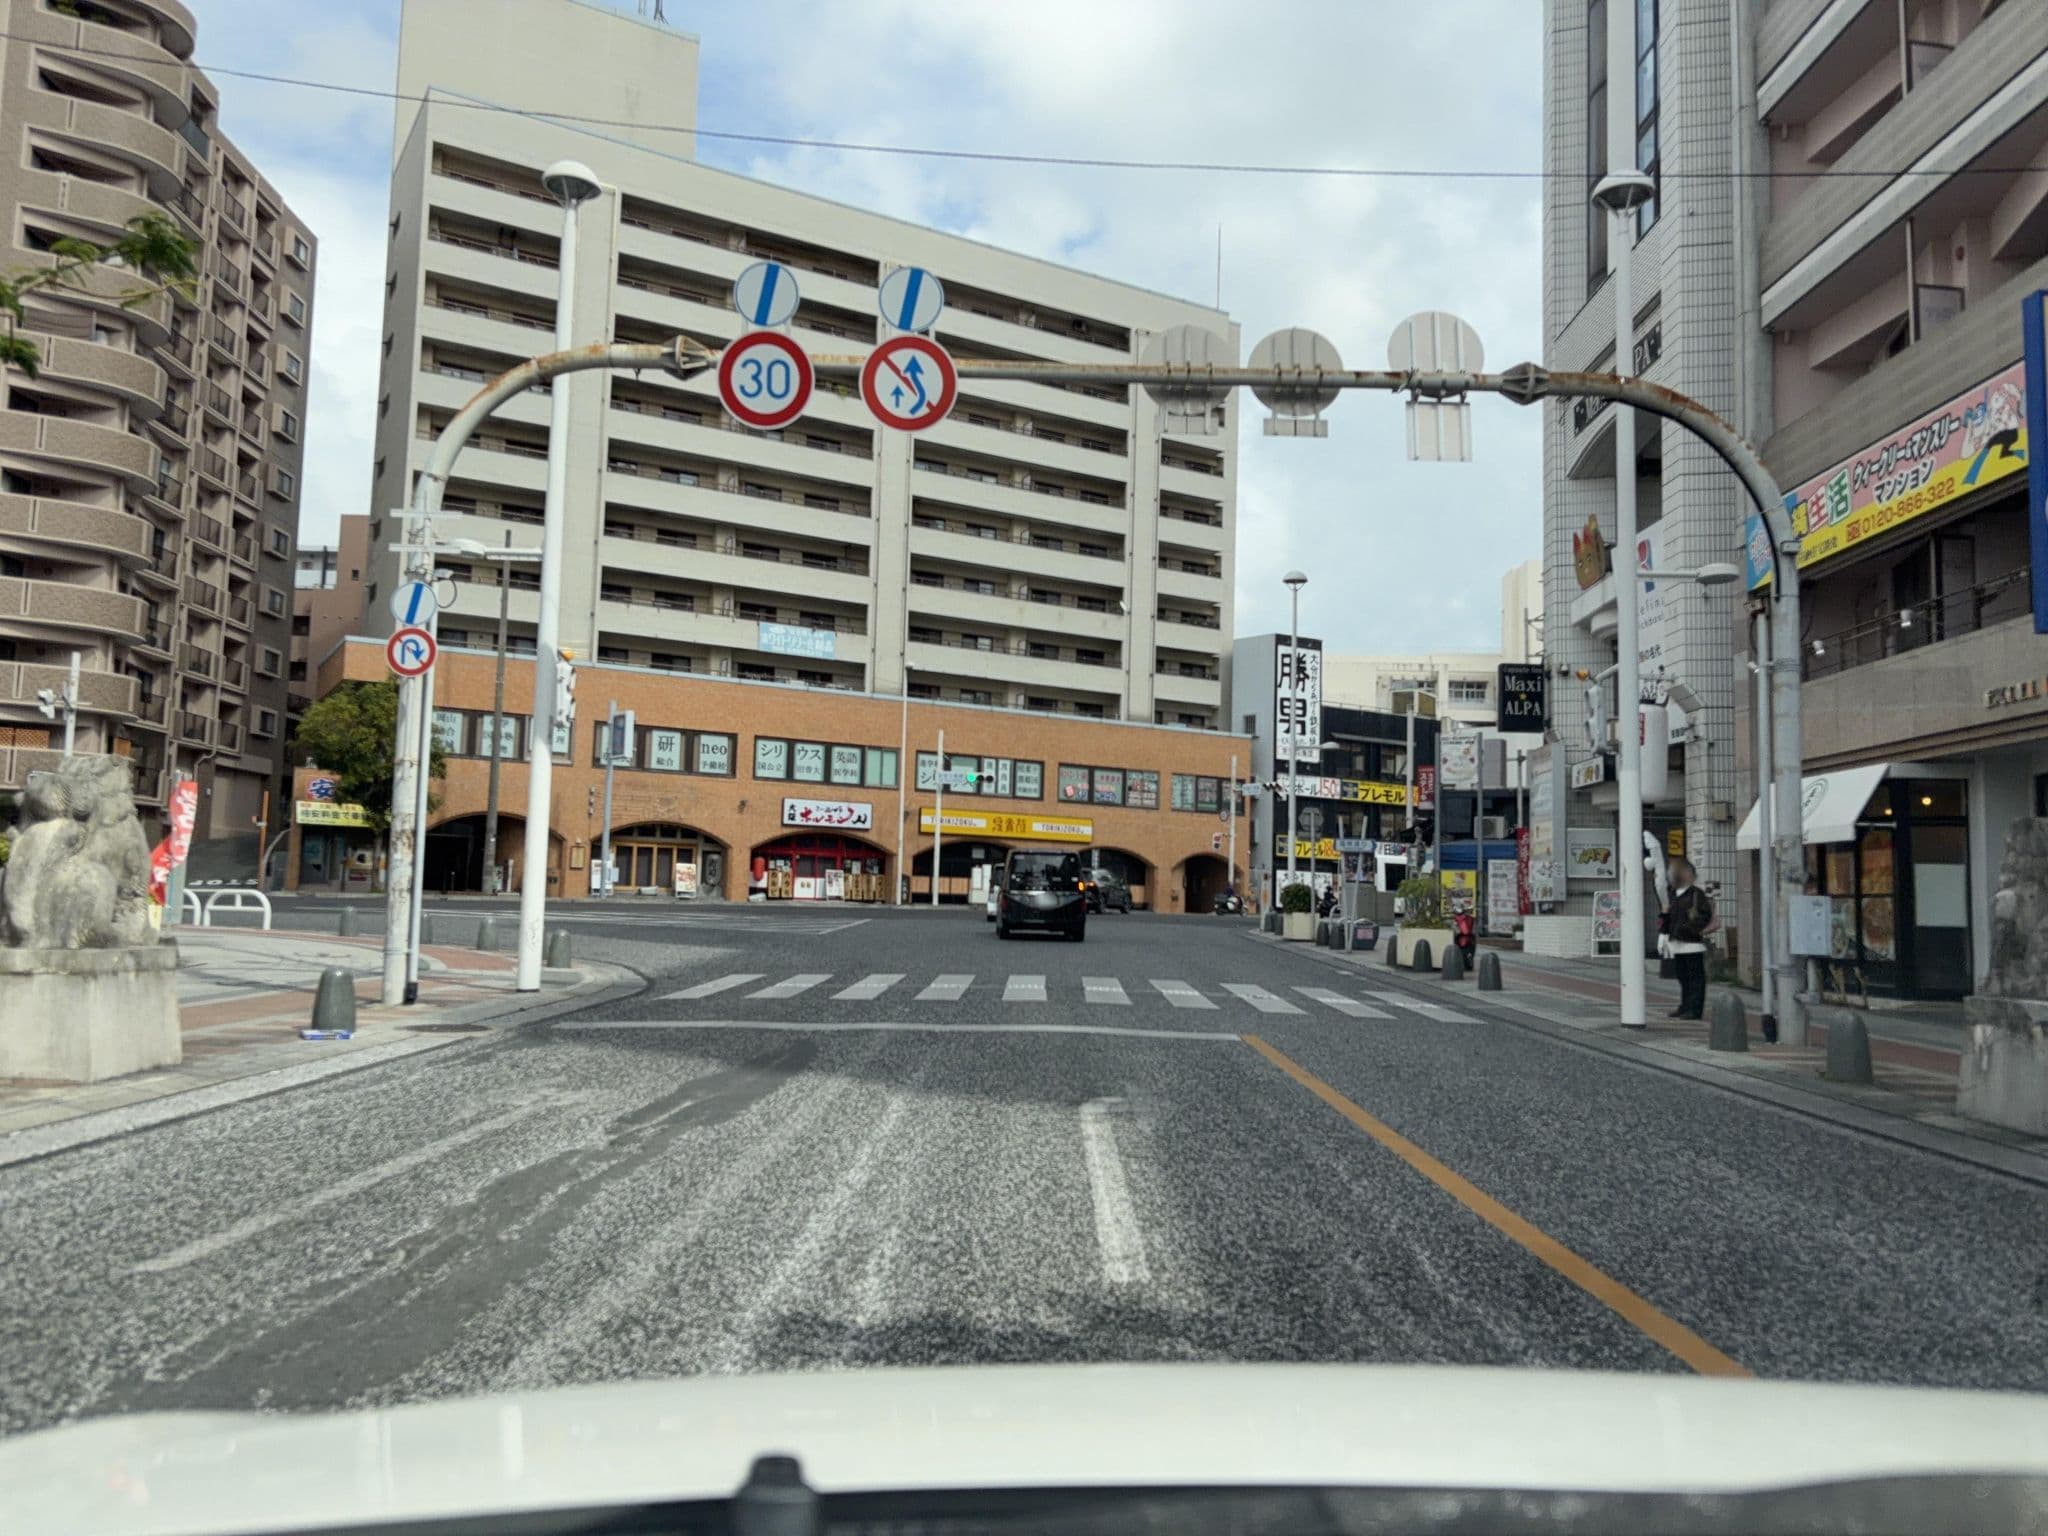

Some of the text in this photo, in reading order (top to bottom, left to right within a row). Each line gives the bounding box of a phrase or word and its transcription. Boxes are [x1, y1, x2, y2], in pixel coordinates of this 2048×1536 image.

[739, 358, 791, 399] 30
[1874, 459, 1935, 503] マンション
[1792, 469, 1850, 538] 生活
[1504, 675, 1541, 692] Maxi
[1504, 700, 1541, 716] ALPA
[658, 735, 727, 755] 研 neo
[930, 816, 973, 827] TRIKIZOKU
